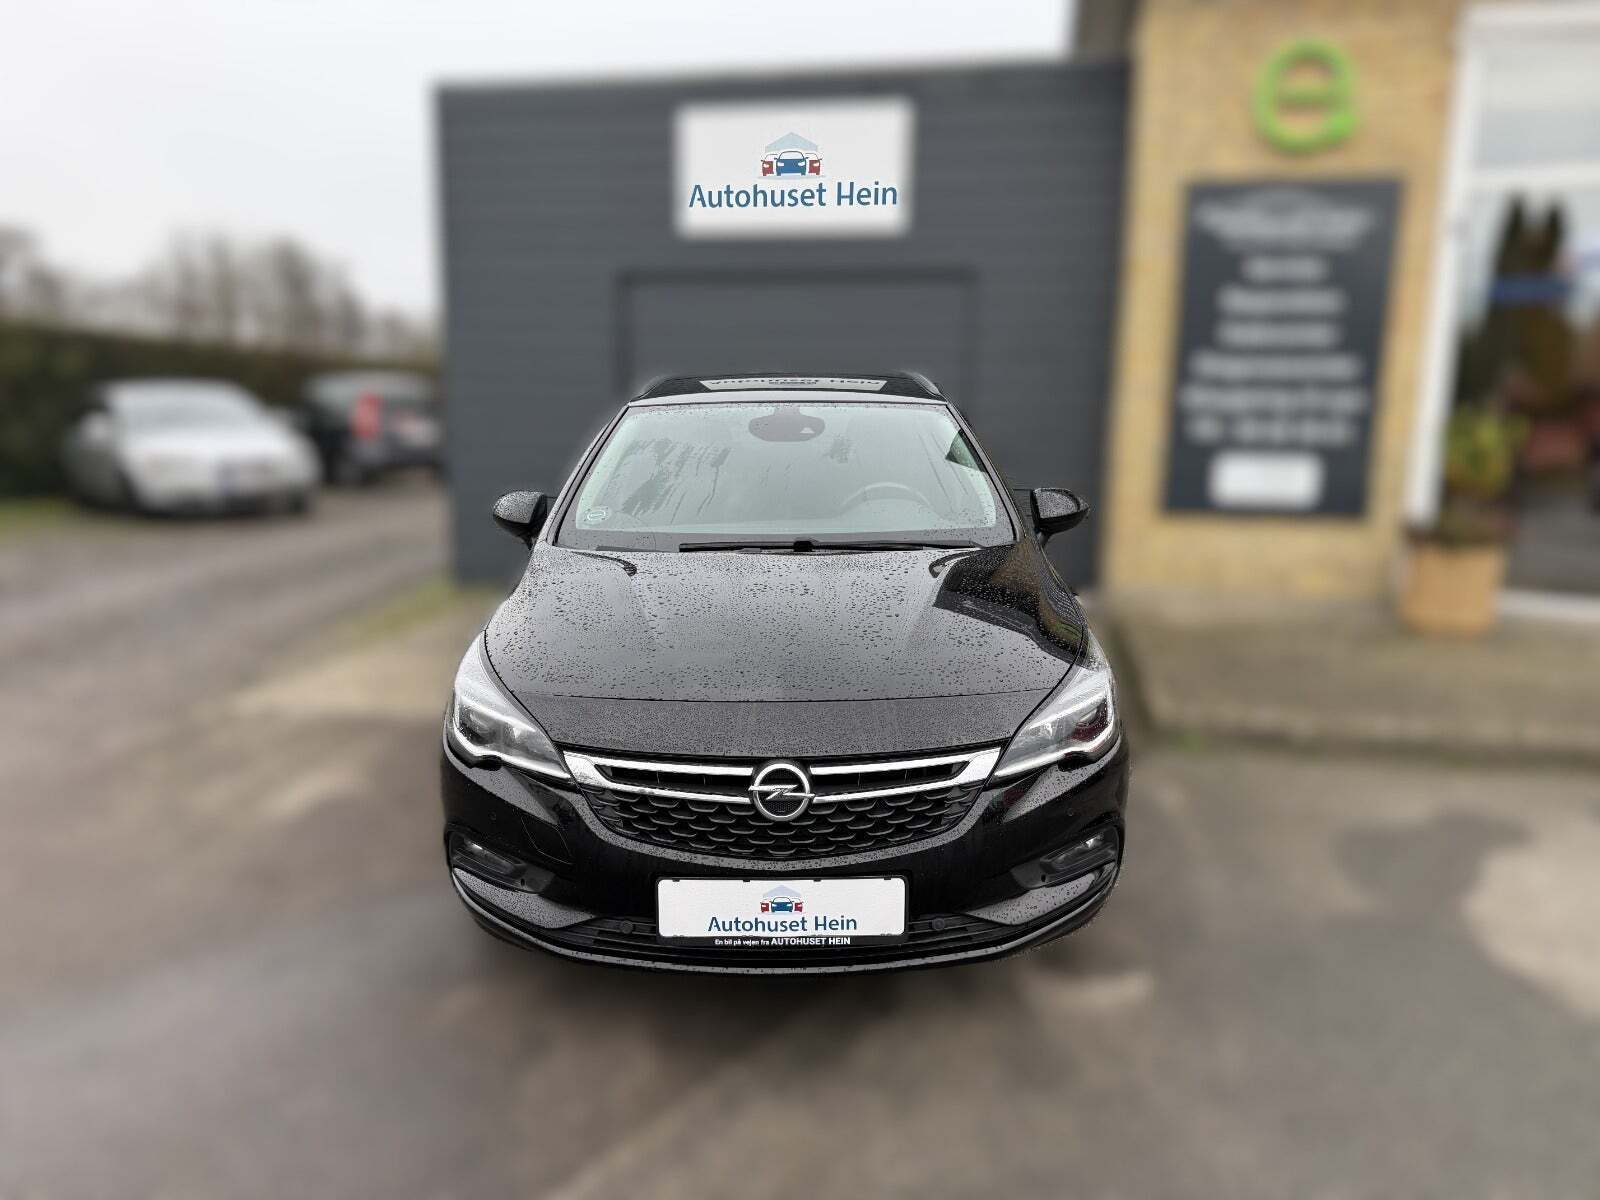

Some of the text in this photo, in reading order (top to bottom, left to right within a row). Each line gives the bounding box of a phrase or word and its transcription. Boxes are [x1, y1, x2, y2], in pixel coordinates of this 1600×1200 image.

[688, 181, 898, 208] Autohuset Hein
[707, 915, 857, 932] Autohuset Hein
[733, 938, 742, 947] på
[742, 939, 760, 947] vejen
[828, 937, 851, 945] HEIN
